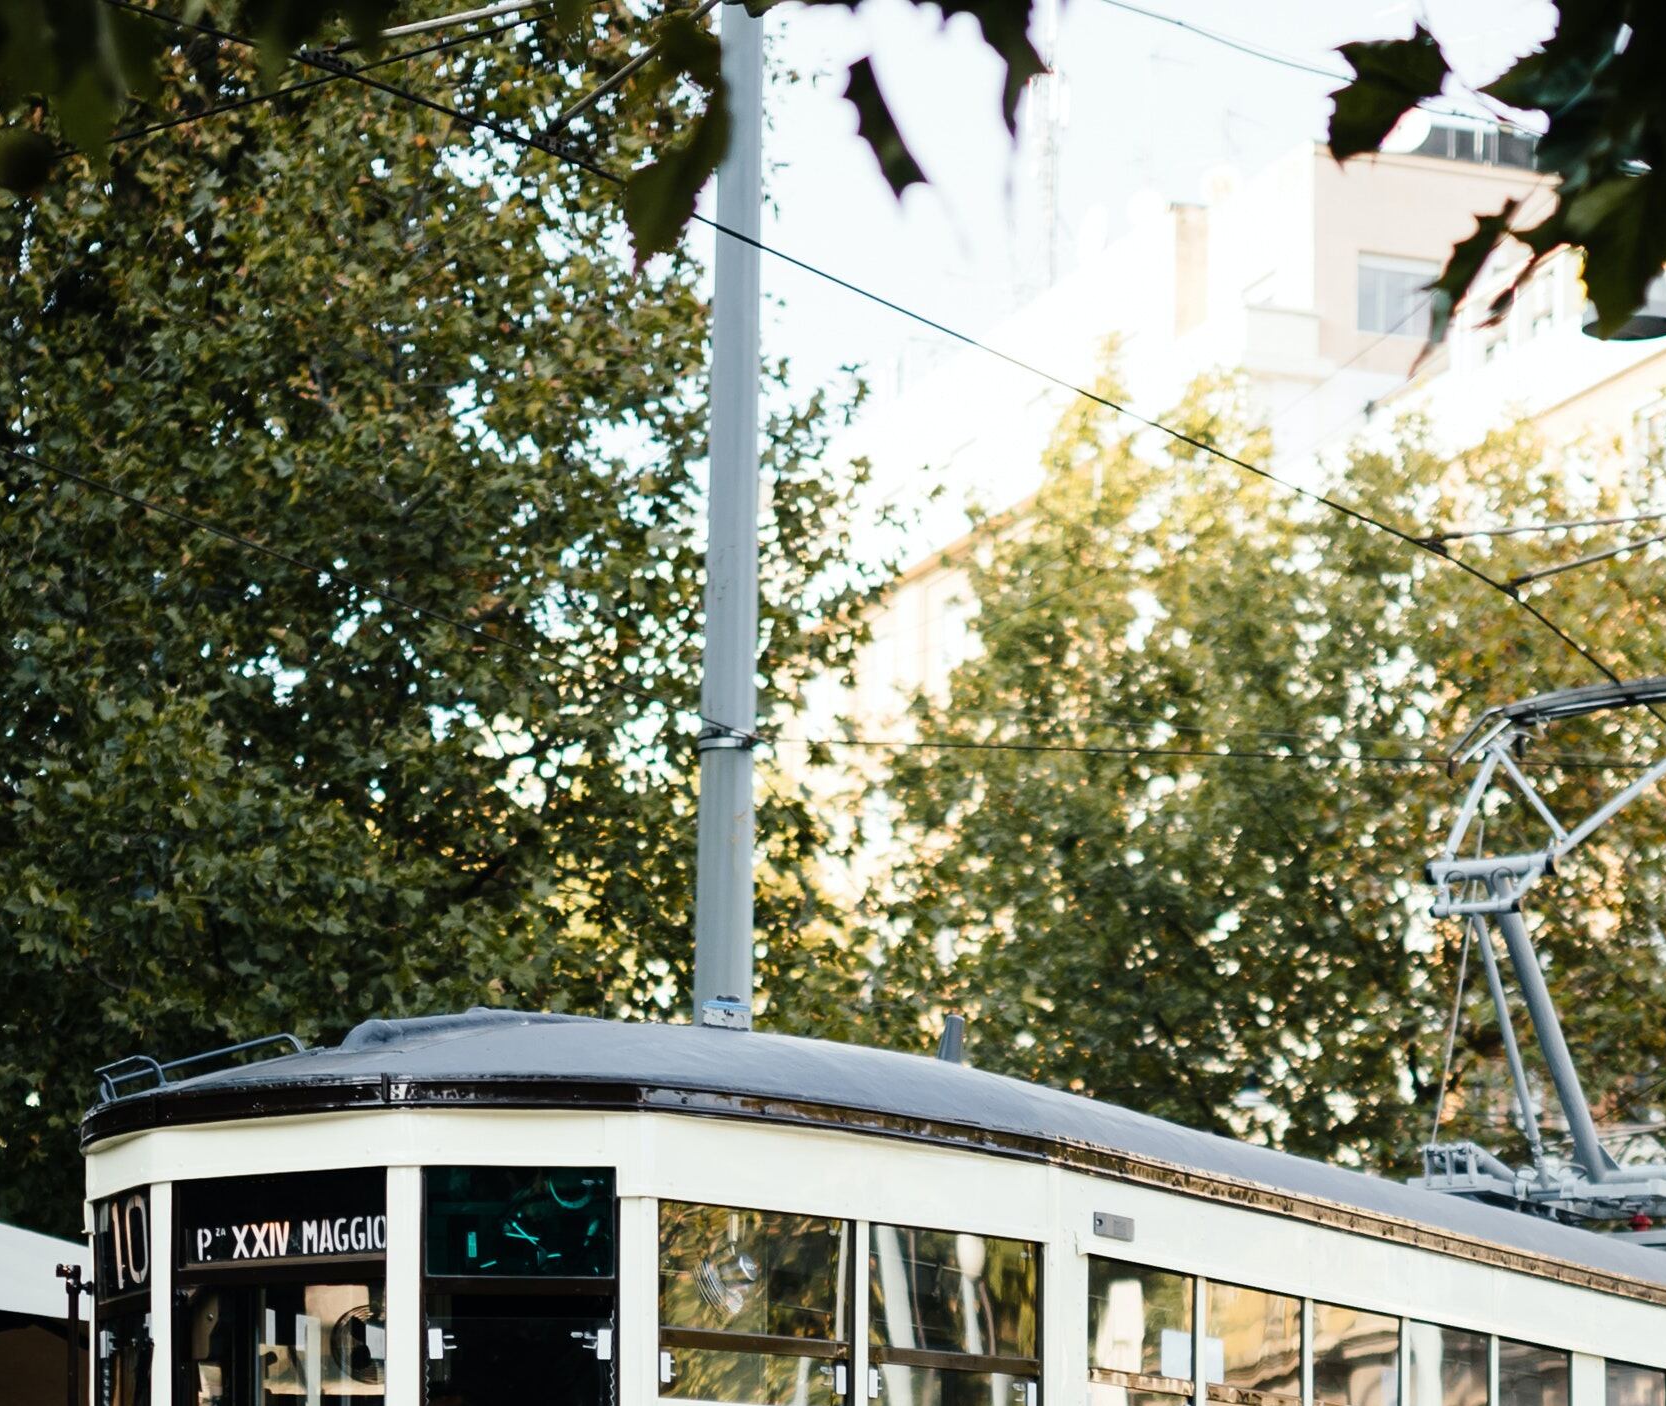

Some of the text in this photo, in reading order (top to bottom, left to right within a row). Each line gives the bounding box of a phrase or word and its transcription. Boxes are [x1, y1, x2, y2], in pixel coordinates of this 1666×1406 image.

[111, 1194, 149, 1290] 10
[231, 1221, 290, 1259] XXIV
[302, 1215, 387, 1255] MAGGIO
